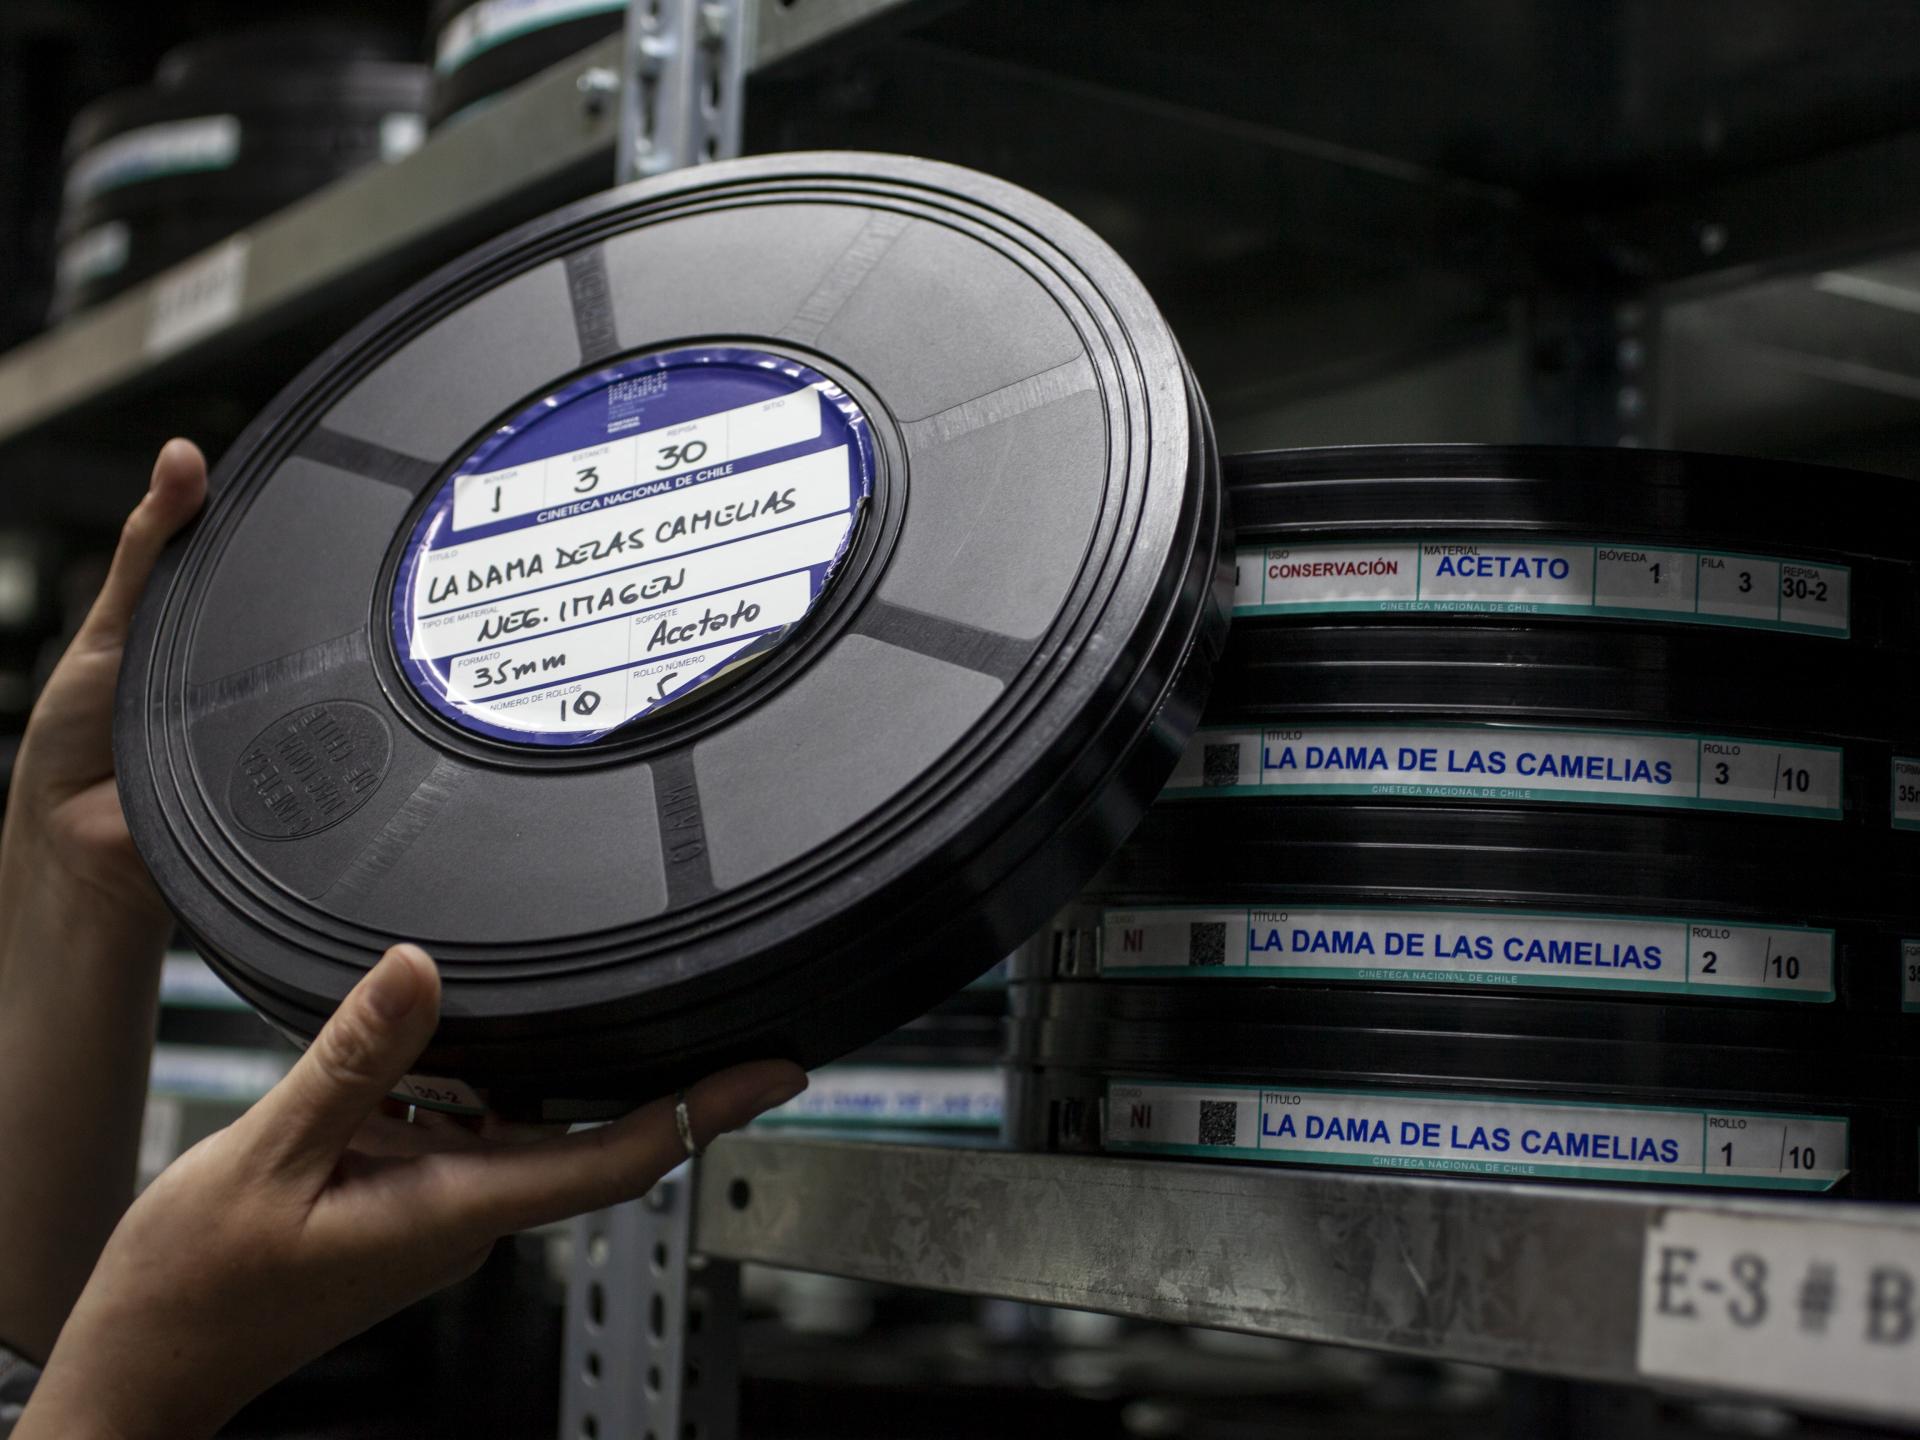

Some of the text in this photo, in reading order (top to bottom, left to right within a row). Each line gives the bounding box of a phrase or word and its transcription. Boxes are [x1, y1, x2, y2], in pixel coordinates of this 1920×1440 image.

[656, 440, 707, 471] 30
[574, 466, 599, 493] 3
[536, 464, 733, 523] CINETECA NACIONAL DE CHILE
[656, 488, 796, 543] CAMELIAS
[1268, 549, 1289, 559] USO
[1423, 545, 1480, 556] MATERIAL
[1598, 549, 1648, 563] BÓVEDA
[1268, 557, 1398, 579] CONSERVACIÓN
[1436, 556, 1569, 579] ACETATO
[1649, 563, 1661, 584] 1
[1702, 558, 1725, 569] FILA
[1783, 566, 1820, 579] REPISA
[1739, 572, 1752, 593] 3
[1782, 578, 1828, 601] 30-2
[421, 605, 499, 630] TIPO DE MATERIAL
[635, 608, 678, 625] SOPORTE
[1379, 602, 1538, 614] CINETECA NACIONAL DE CHILE
[457, 651, 501, 667] FORMATO
[633, 655, 706, 678] ROLLO NÚMERO
[531, 693, 544, 703] DE
[546, 684, 582, 699] ROLLOS
[1703, 743, 1741, 756] ROLLO
[1264, 747, 1673, 785] LA DAMA DE LAS CAMELIAS
[1715, 763, 1730, 785] 3
[1371, 785, 1532, 799] CINETECA NACIONAL DE CHILE
[1692, 928, 1730, 940] ROLLO
[1250, 929, 1662, 970] LA DAMA DE LAS CAMELIAS
[1702, 951, 1717, 974] 2
[1358, 970, 1518, 984] CINETECA NACIONAL DE CHILE
[1709, 1117, 1747, 1130] ROLLO
[1263, 1113, 1679, 1163] LA DAMA DE LAS CAMELIAS
[1721, 1142, 1733, 1166] 1
[1372, 1157, 1536, 1174] CINETECA NACIONAL DE CHILE
